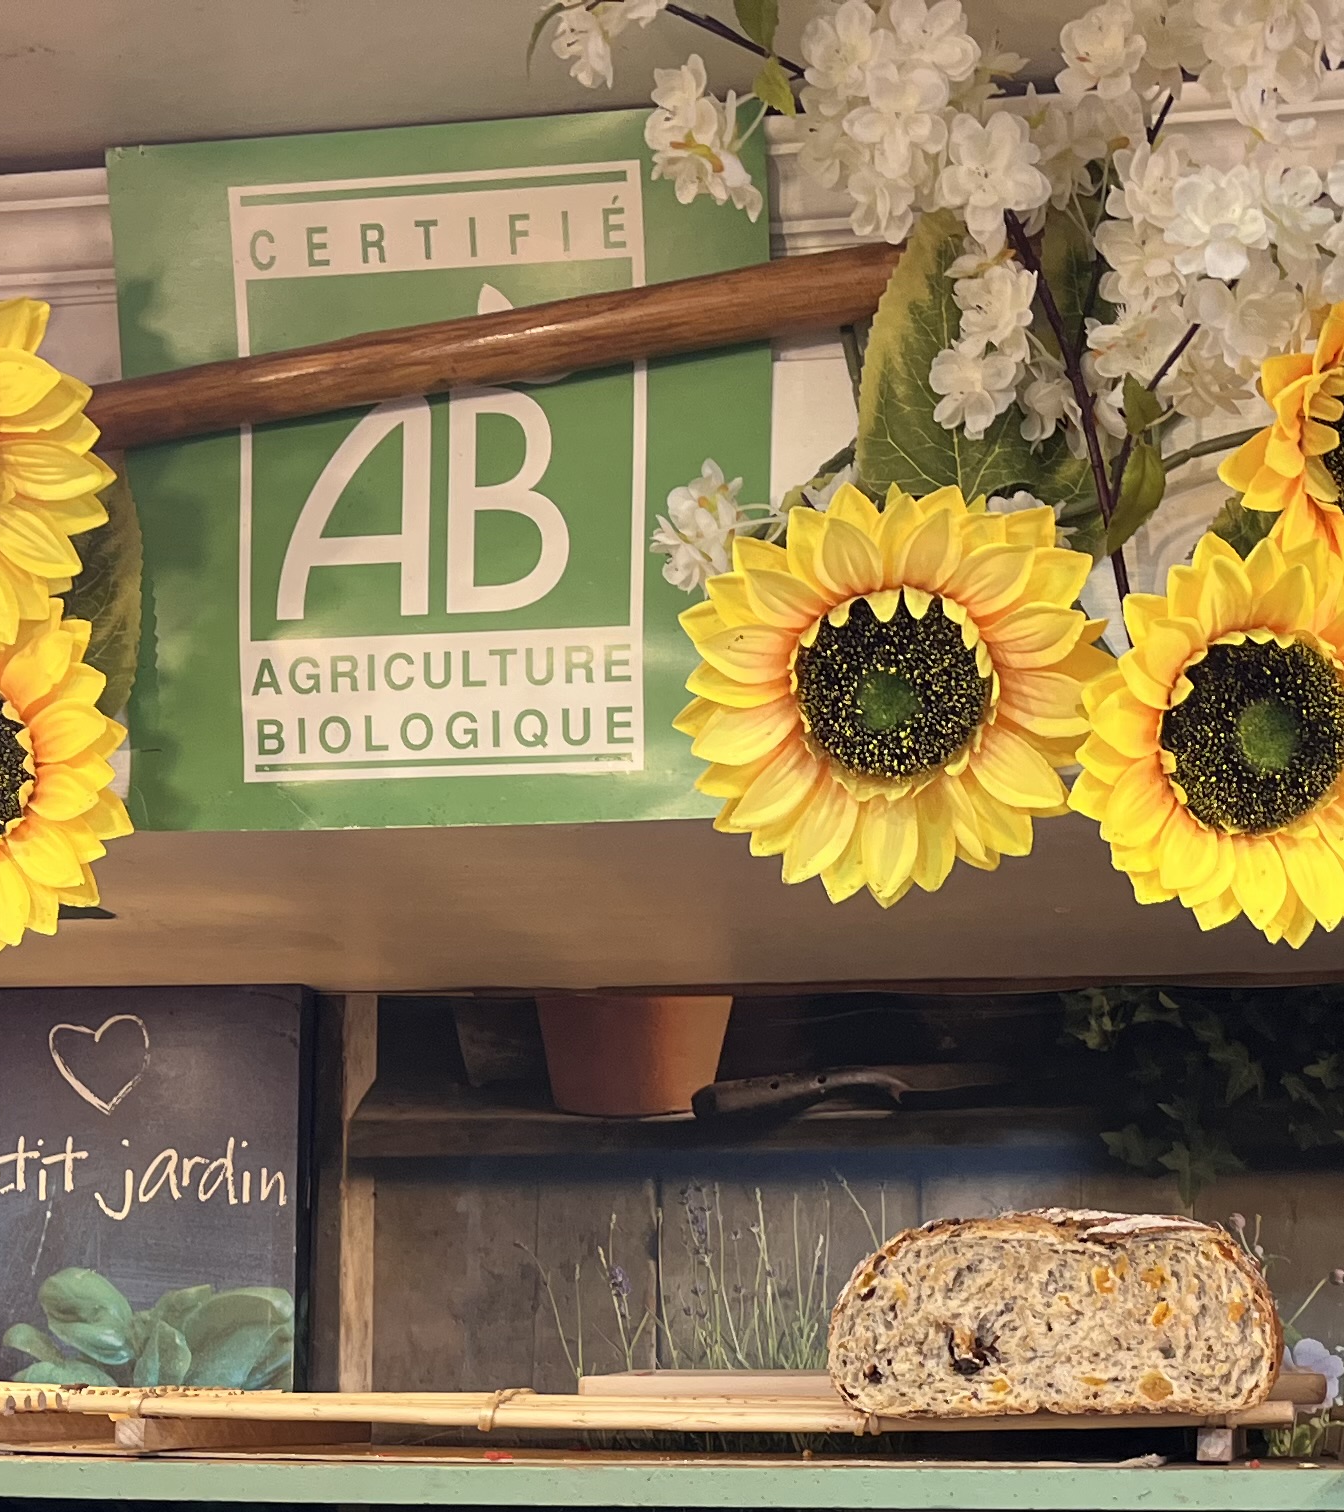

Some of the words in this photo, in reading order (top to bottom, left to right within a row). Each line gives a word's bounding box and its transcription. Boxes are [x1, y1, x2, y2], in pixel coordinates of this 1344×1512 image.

[248, 194, 627, 272] CERTIFIÉ
[276, 386, 570, 620] AB
[251, 643, 633, 696] AGRICULTURE
[256, 705, 635, 757] BIOLOGIQUE
[94, 1136, 288, 1220] jardin
